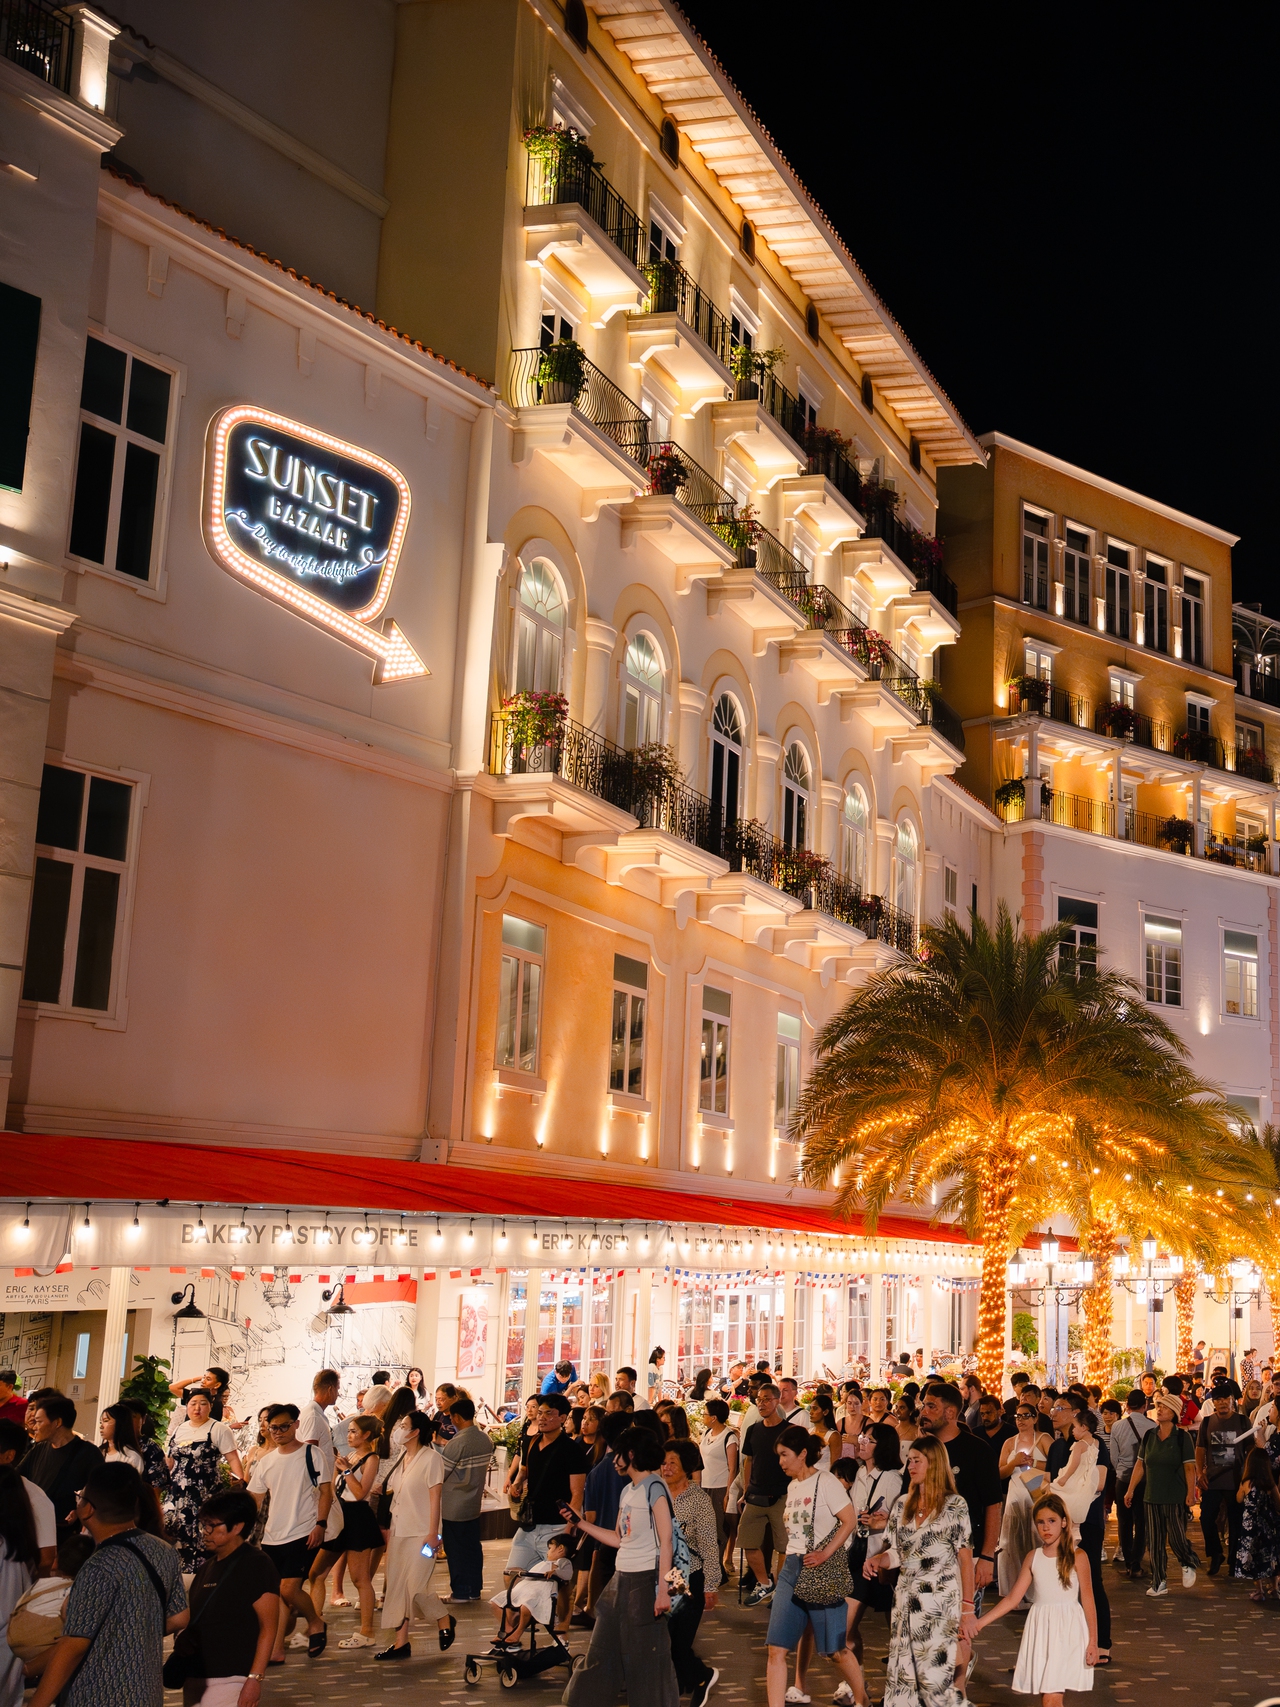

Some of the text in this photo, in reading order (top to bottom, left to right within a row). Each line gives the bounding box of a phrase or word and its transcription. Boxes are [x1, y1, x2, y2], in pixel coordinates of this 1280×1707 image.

[245, 437, 379, 531] SUNSET
[269, 496, 350, 551] BAZAAR
[319, 560, 360, 585] delights
[182, 1224, 418, 1247] BAKERY PASTRY COFFEE
[542, 1233, 629, 1251] ERIC KAYSER
[6, 1285, 70, 1293] ERIC KAYSER
